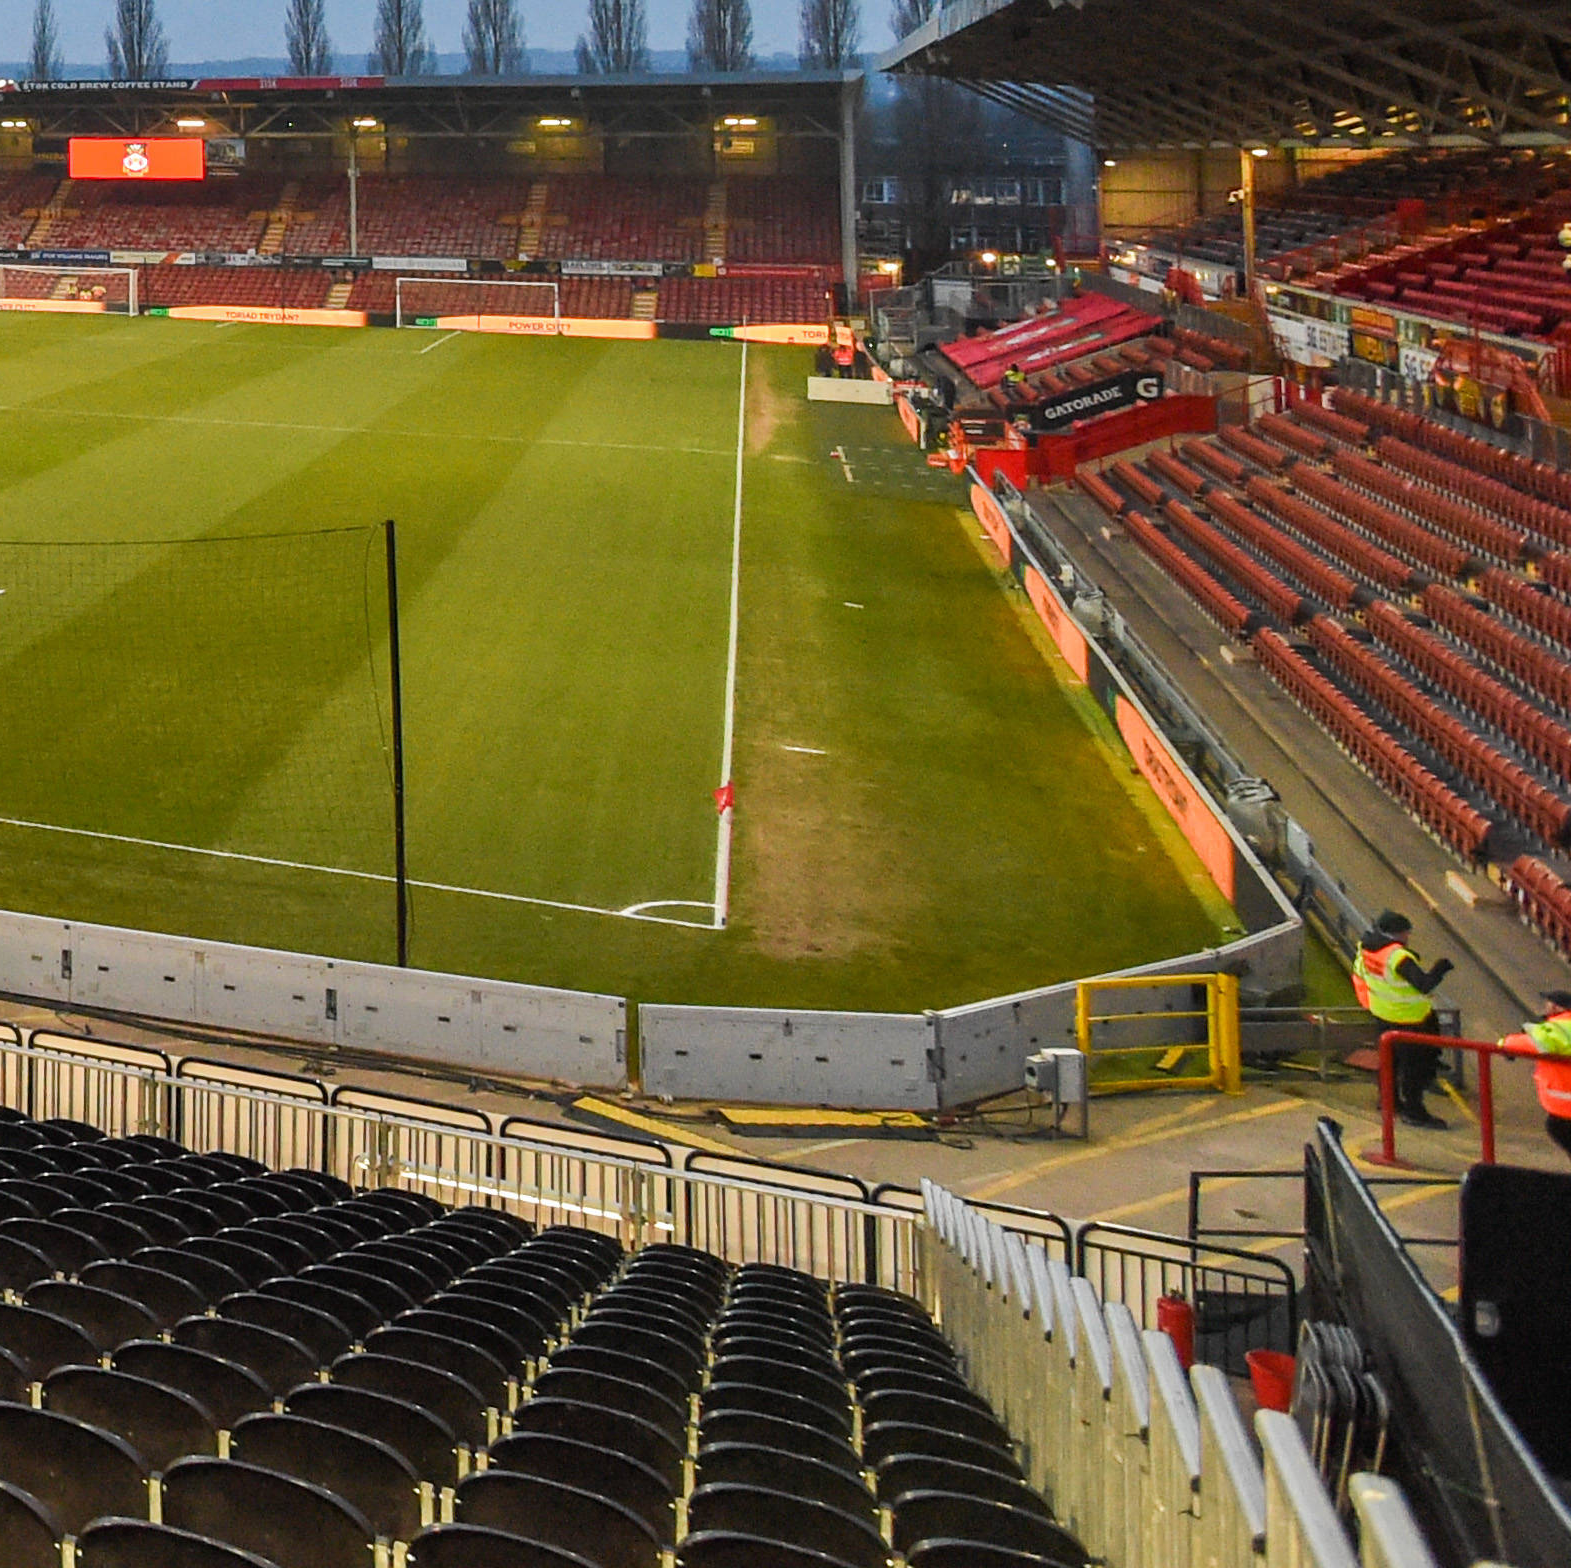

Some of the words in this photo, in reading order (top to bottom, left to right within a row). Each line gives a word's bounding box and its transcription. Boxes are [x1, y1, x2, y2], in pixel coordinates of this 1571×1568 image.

[509, 322, 545, 330] POWER
[1136, 377, 1159, 399] G
[1045, 386, 1122, 420] GATORADE
